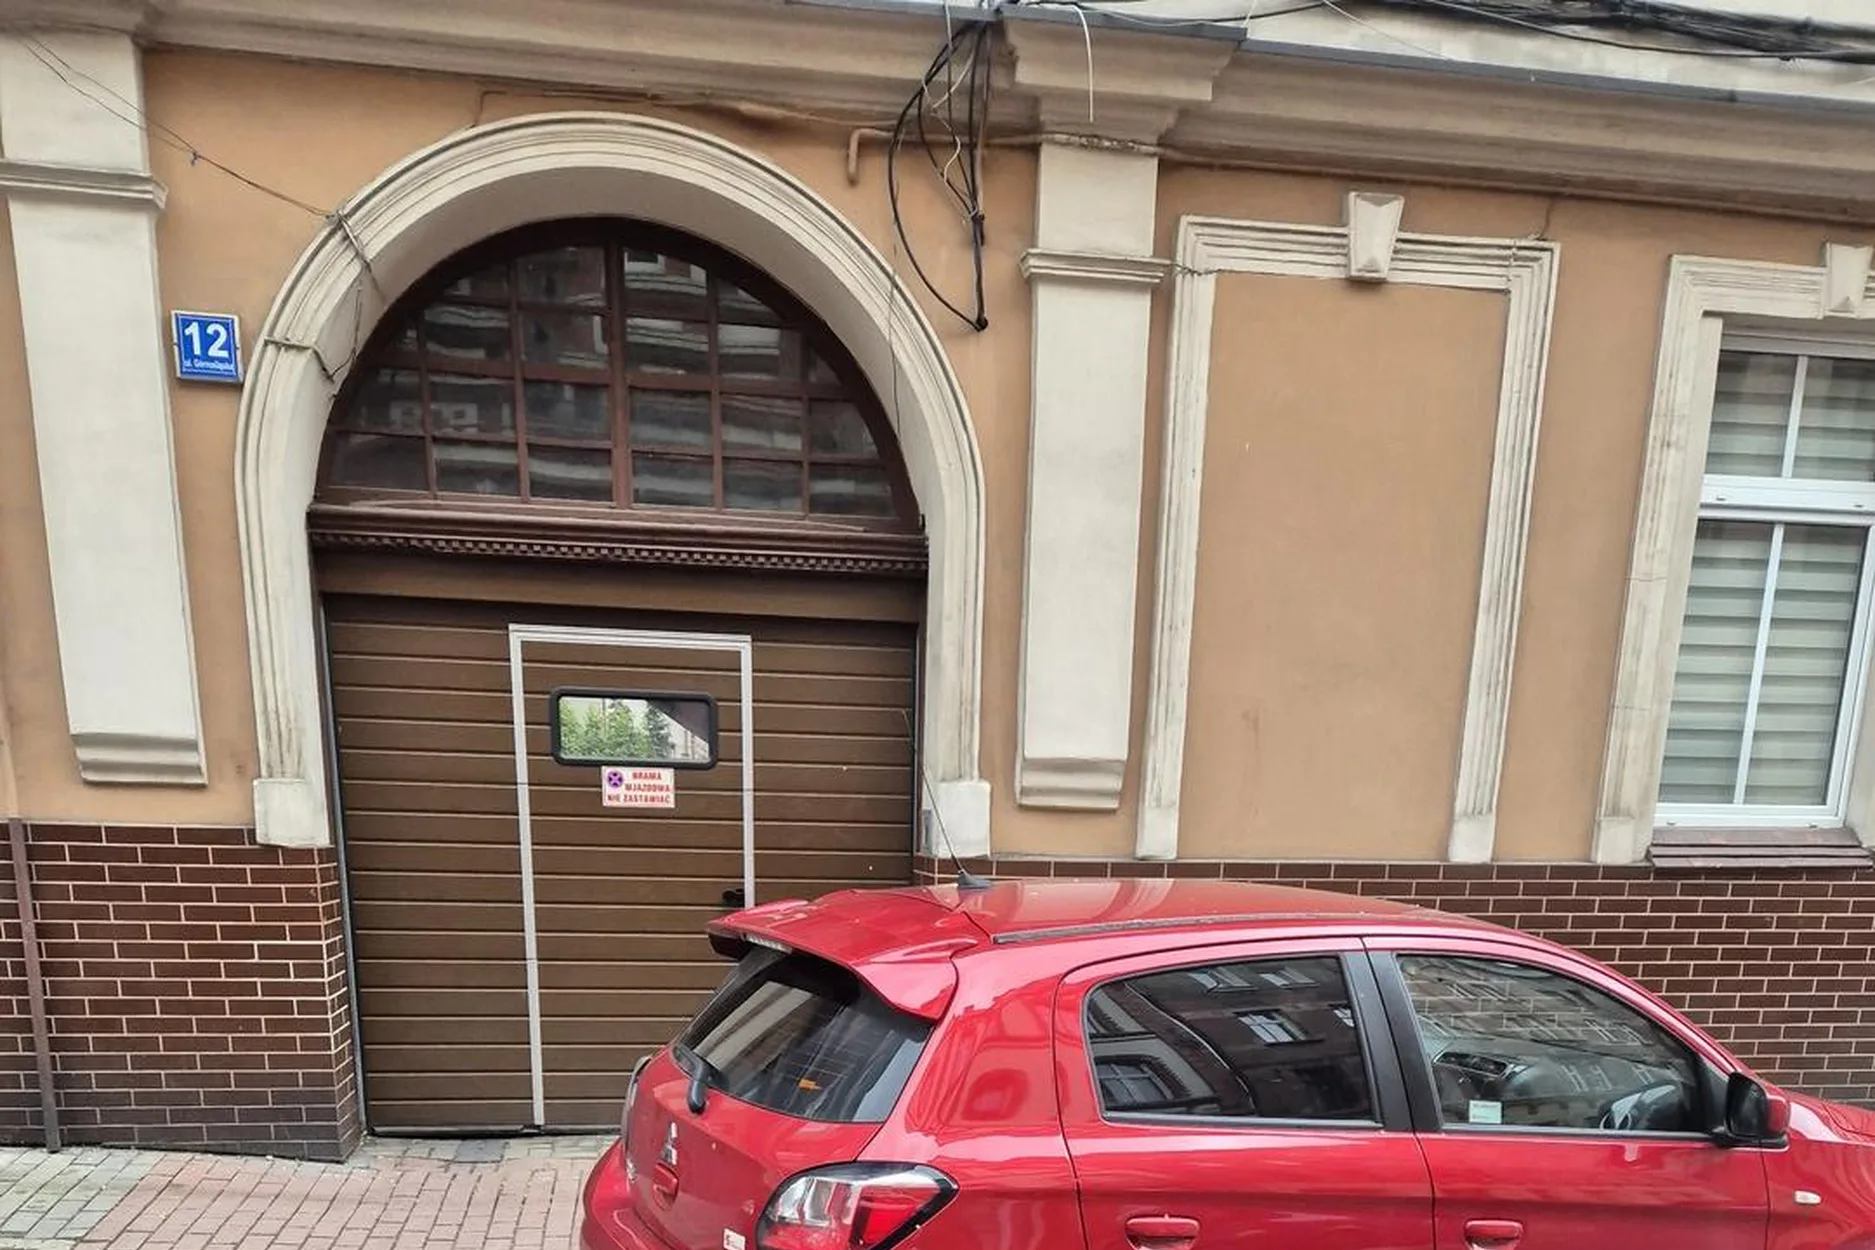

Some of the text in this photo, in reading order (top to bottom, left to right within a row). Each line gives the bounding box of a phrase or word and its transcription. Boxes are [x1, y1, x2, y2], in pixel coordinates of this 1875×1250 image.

[184, 321, 229, 358] 12
[632, 772, 662, 780] BRAMA
[625, 783, 670, 792] WJAZDOWA
[607, 794, 621, 802] NIE
